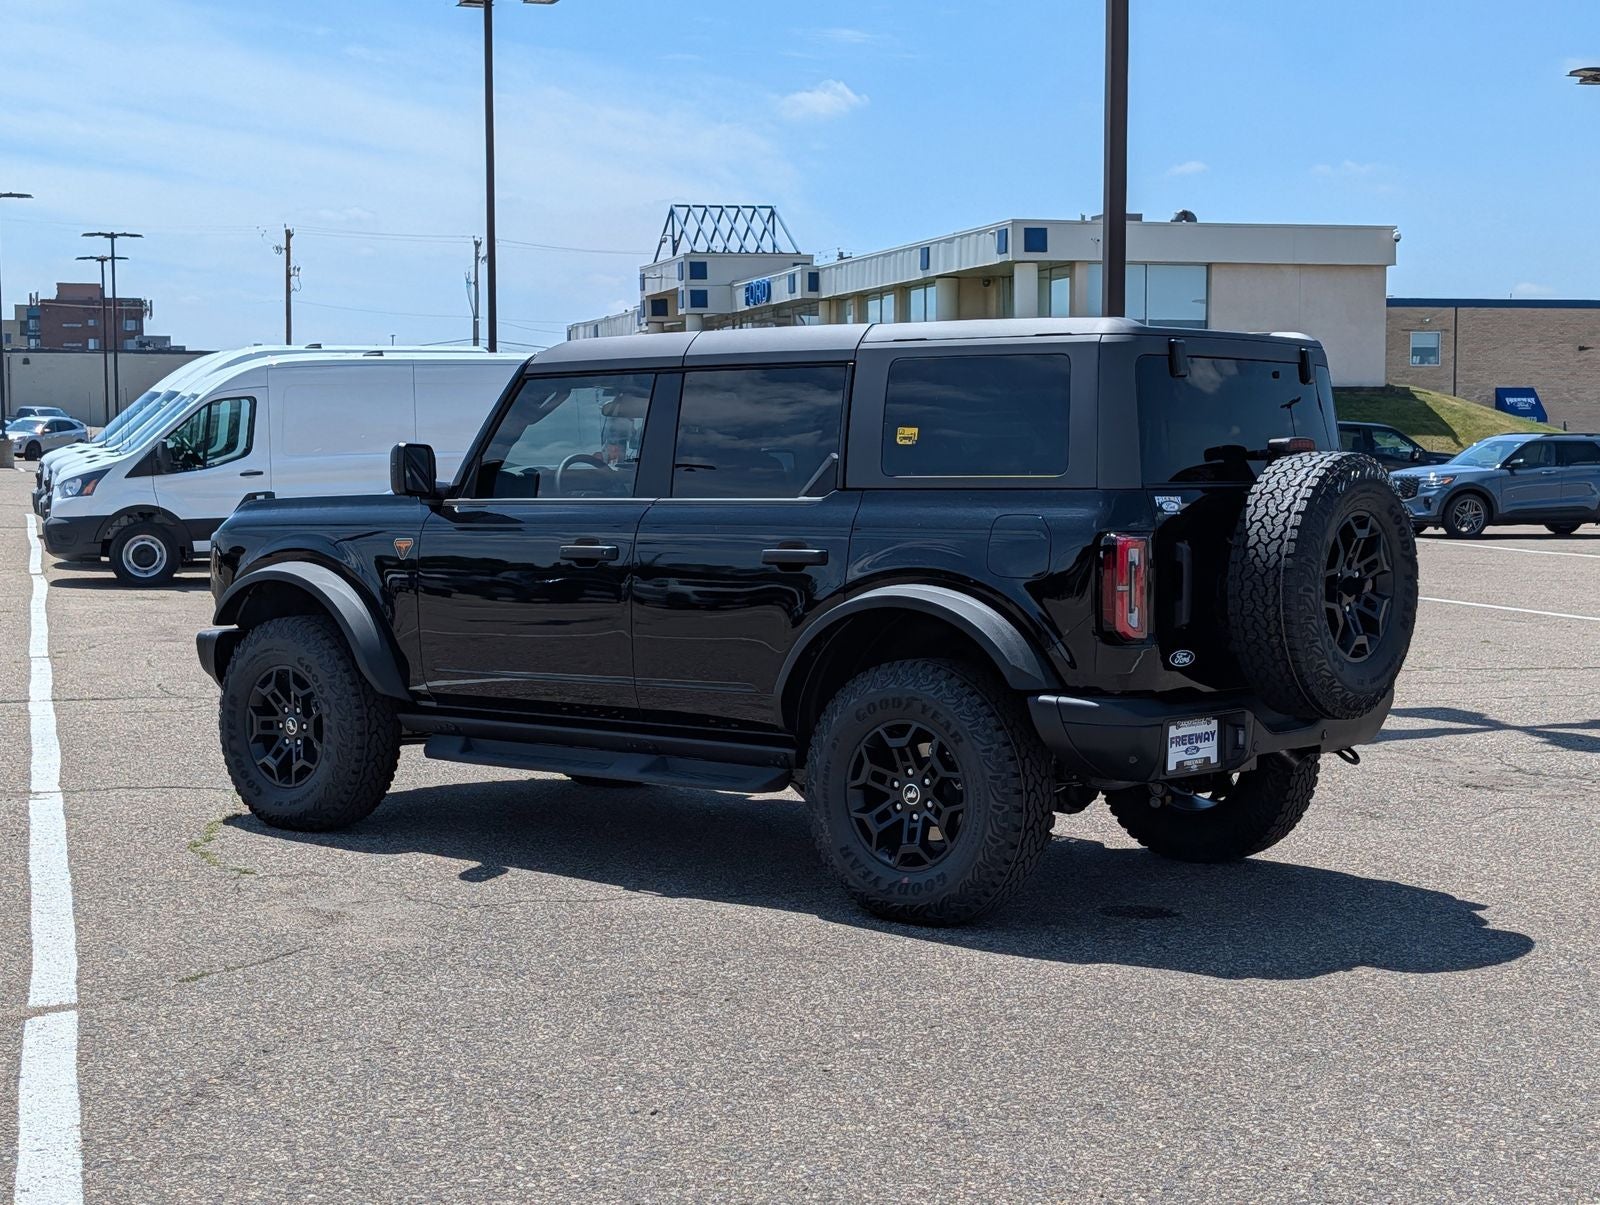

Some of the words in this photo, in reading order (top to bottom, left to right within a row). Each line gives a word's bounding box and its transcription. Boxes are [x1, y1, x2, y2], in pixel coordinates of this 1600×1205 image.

[1174, 652, 1192, 664] Ford
[855, 695, 964, 745] GOODYEAR
[1169, 729, 1216, 749] FREEWAY
